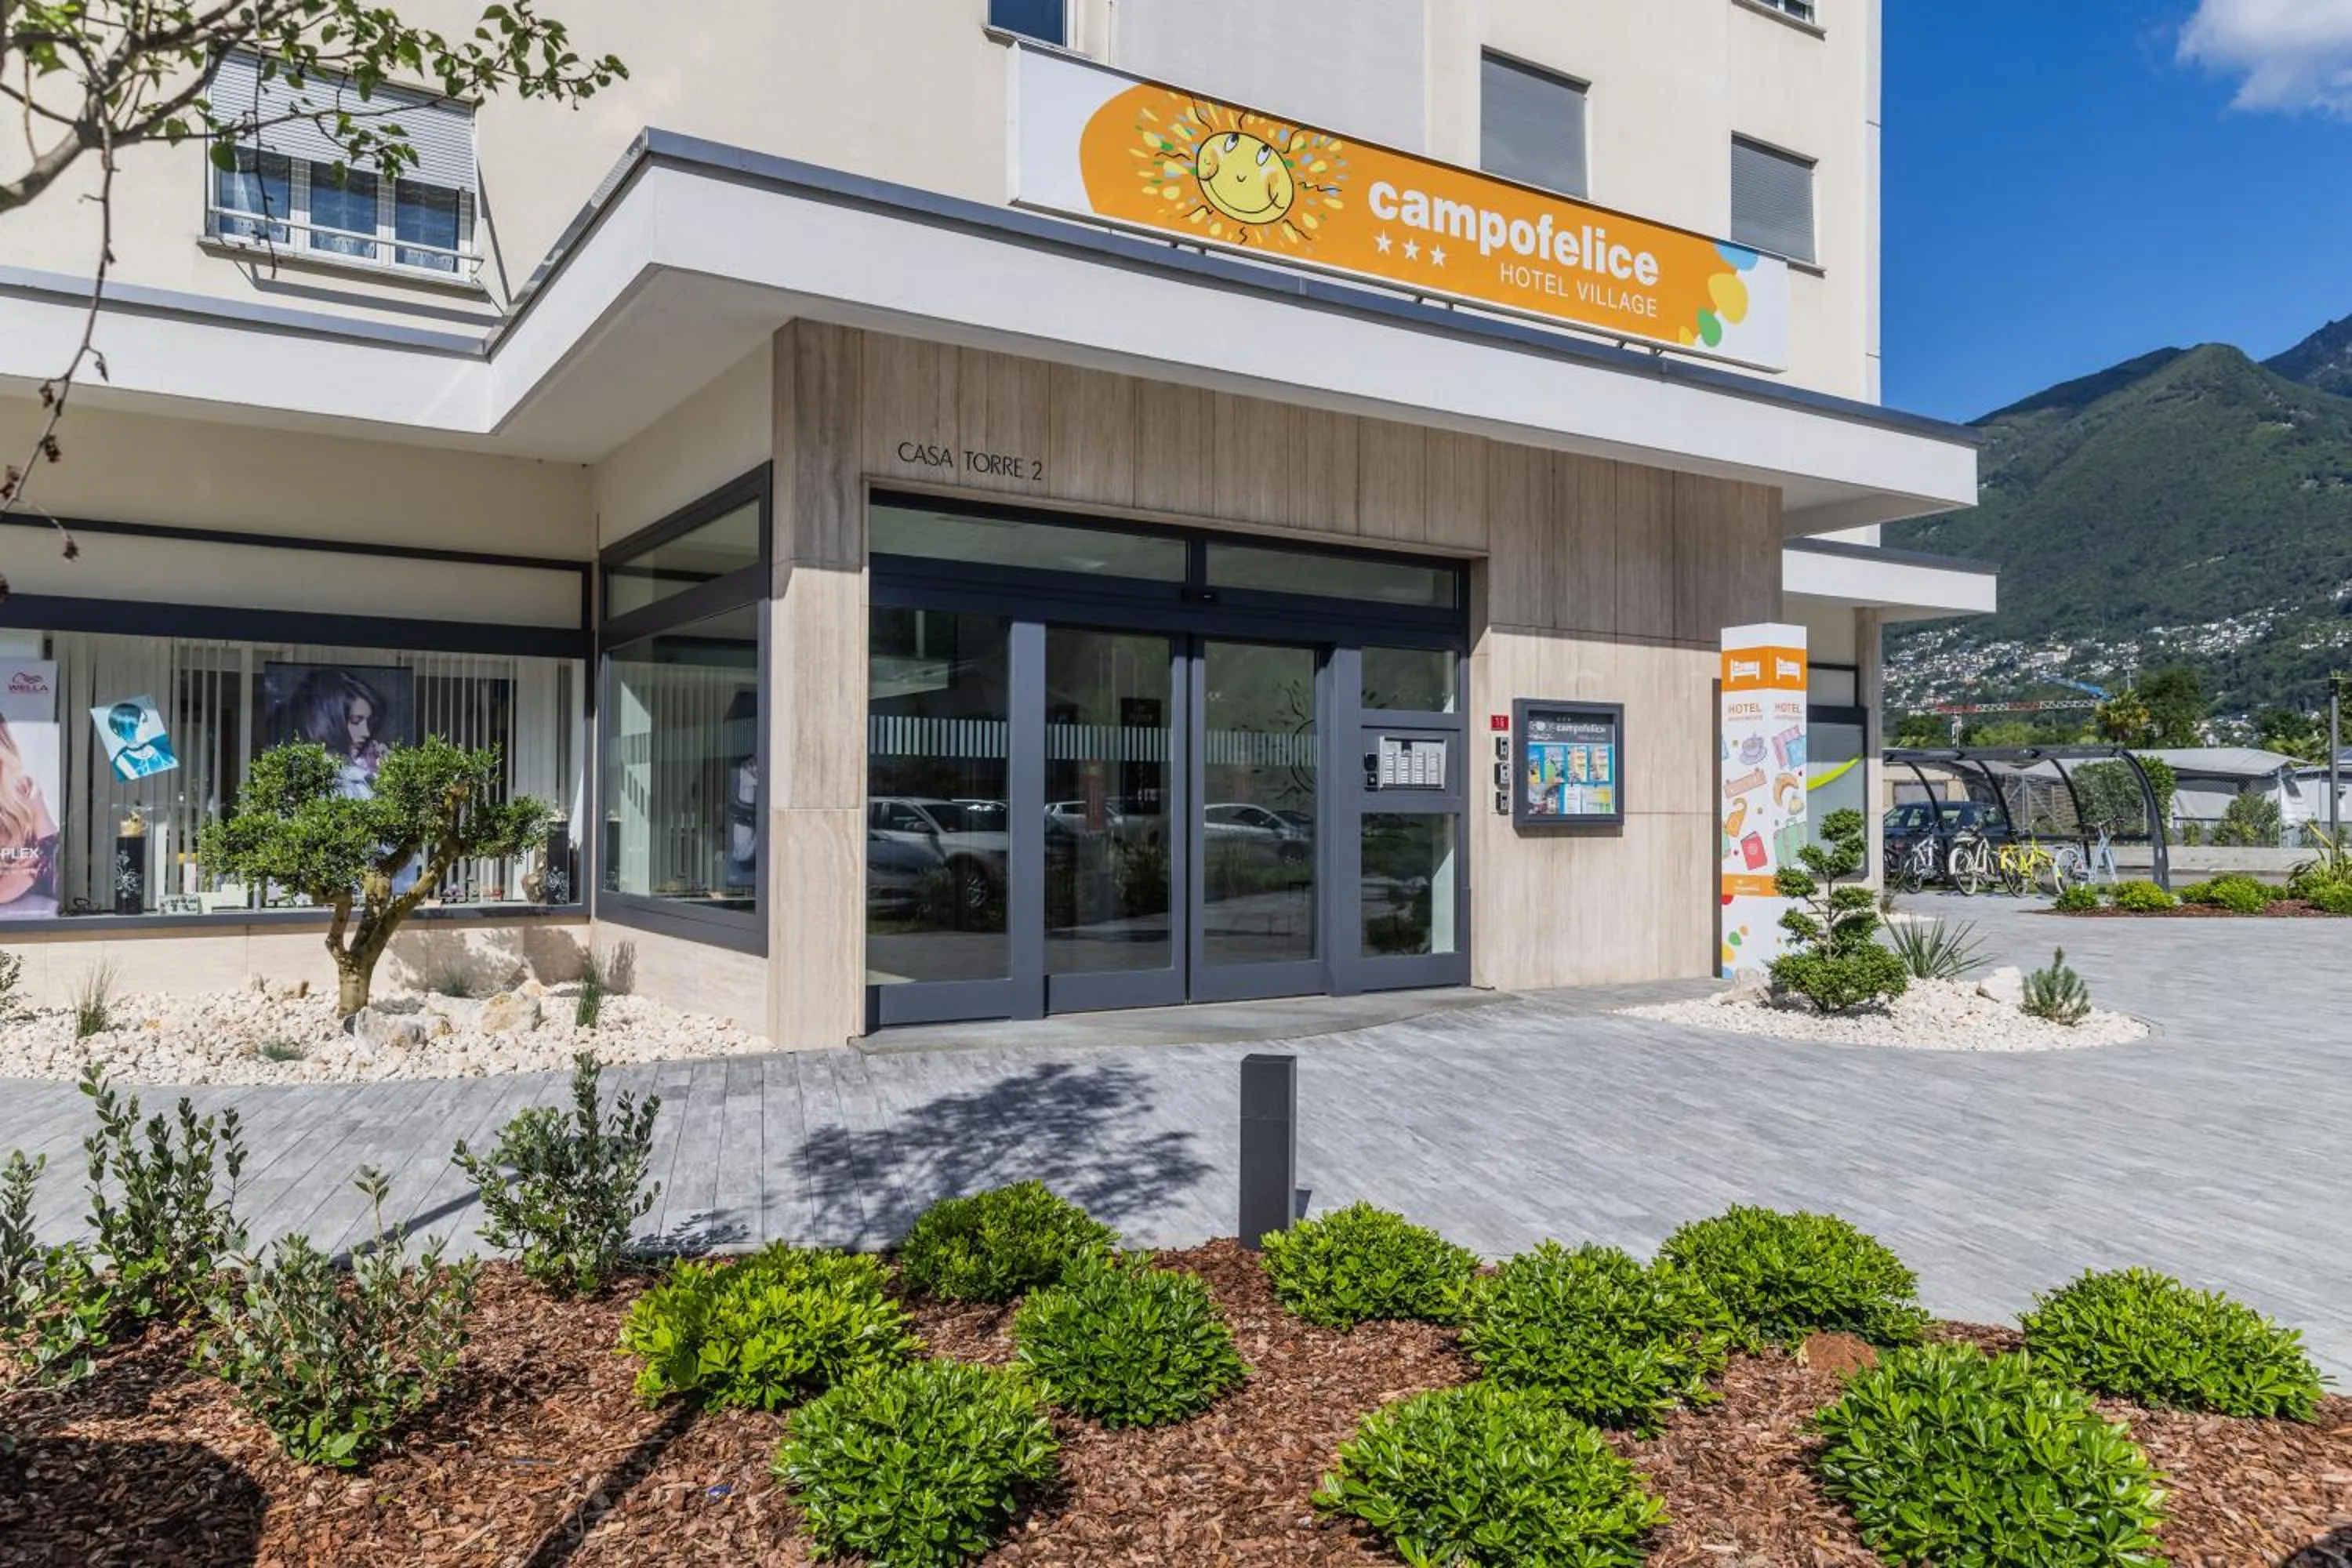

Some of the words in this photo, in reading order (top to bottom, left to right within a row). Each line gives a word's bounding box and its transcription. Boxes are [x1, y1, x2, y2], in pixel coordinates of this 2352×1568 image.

[1367, 180, 1660, 286] campofelice
[1500, 262, 1569, 297] HOTEL
[1576, 281, 1657, 318] VILLAGE
[898, 441, 954, 468] CASA
[964, 450, 1024, 478] TORRE
[1031, 460, 1043, 481] 2
[1728, 702, 1762, 714] HOTEL
[1773, 702, 1802, 714] HOTEL
